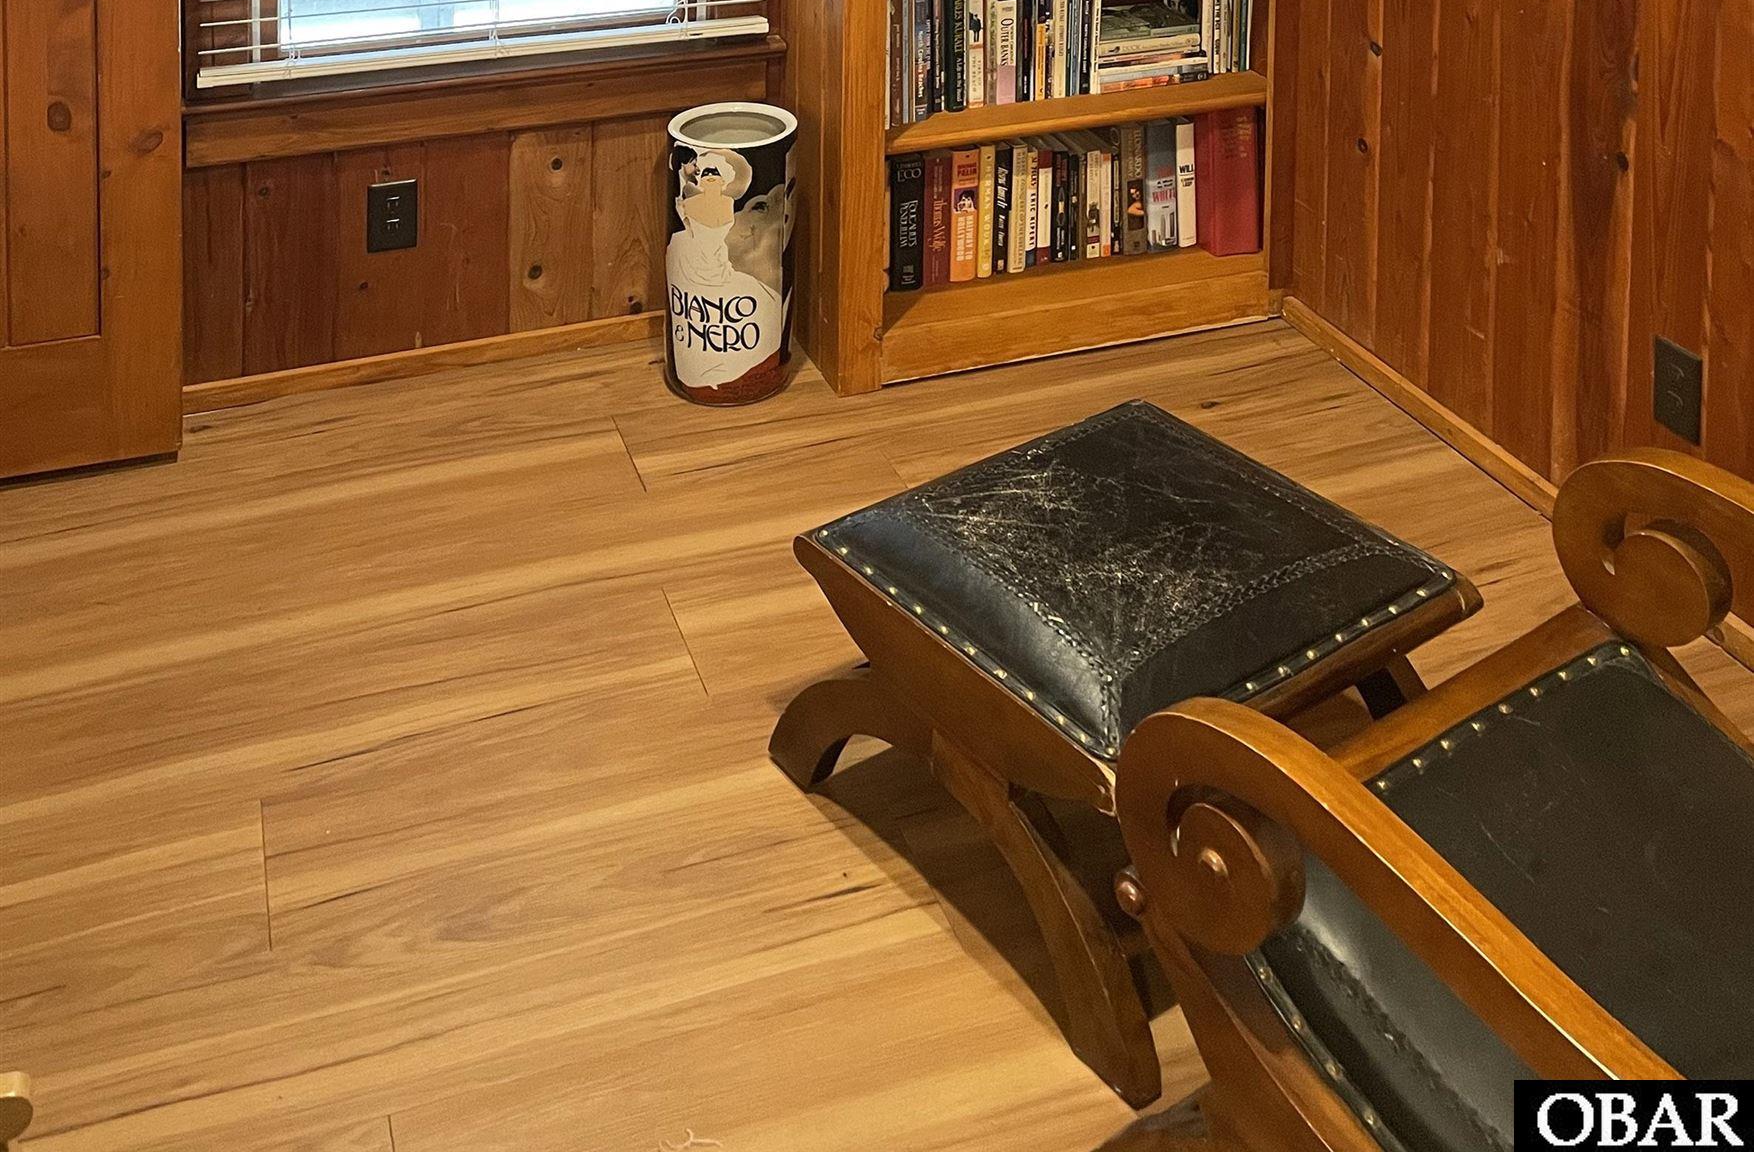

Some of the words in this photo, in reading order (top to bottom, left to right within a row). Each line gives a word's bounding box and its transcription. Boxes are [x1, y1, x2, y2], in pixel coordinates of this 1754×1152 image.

[954, 21, 963, 53] KURALT
[1001, 18, 1015, 44] OUTER
[1000, 45, 1010, 67] BANKS
[983, 166, 992, 209] HERMAN
[933, 198, 948, 227] Thomas
[928, 225, 947, 252] Wolfe
[956, 217, 965, 261] HOLLYWOOD
[965, 215, 974, 248] HALFWAY
[982, 213, 991, 245] WOUK
[1028, 217, 1036, 246] RIPERT
[965, 250, 973, 260] TO
[670, 282, 758, 323] BIANCO
[687, 320, 761, 353] NERO
